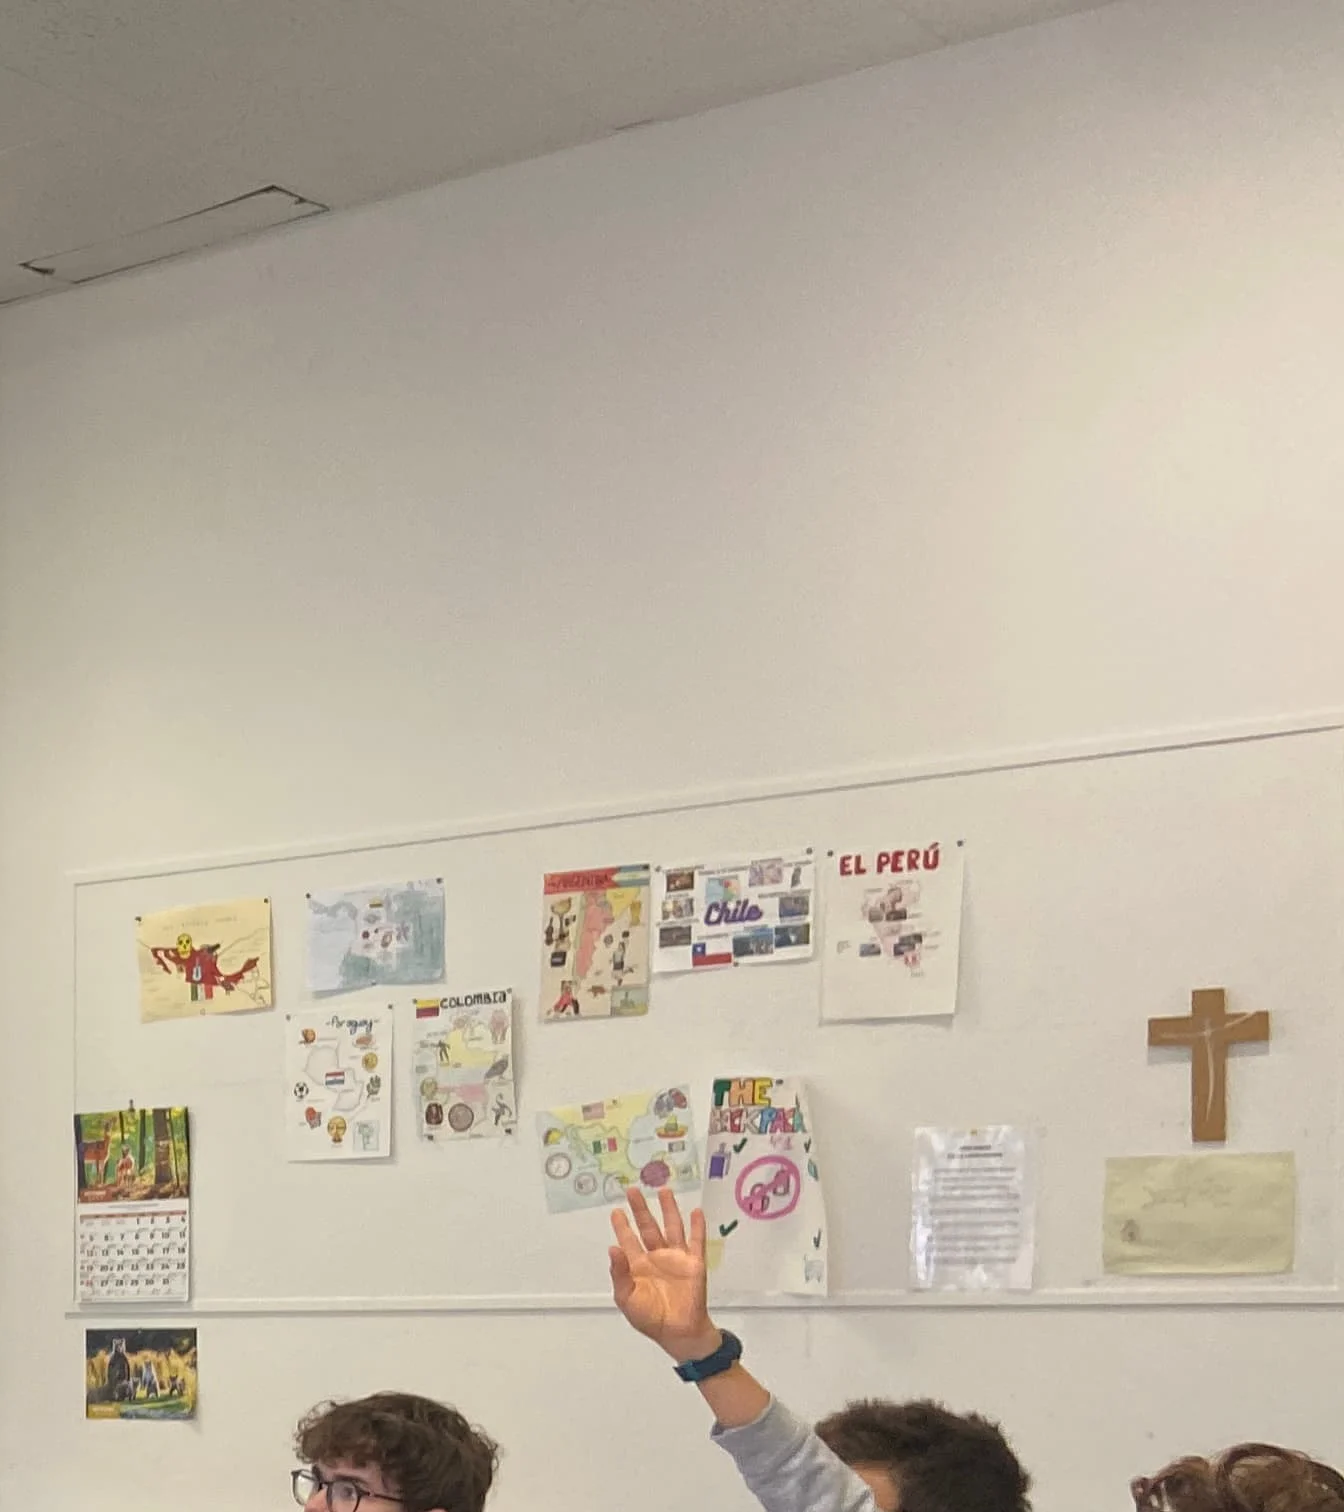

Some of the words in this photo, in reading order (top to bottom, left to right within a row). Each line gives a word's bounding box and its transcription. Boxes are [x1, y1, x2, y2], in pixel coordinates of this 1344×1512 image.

[839, 854, 867, 877] EL
[875, 841, 940, 875] PERÚ
[703, 898, 764, 926] Chile
[713, 1077, 773, 1107] THE
